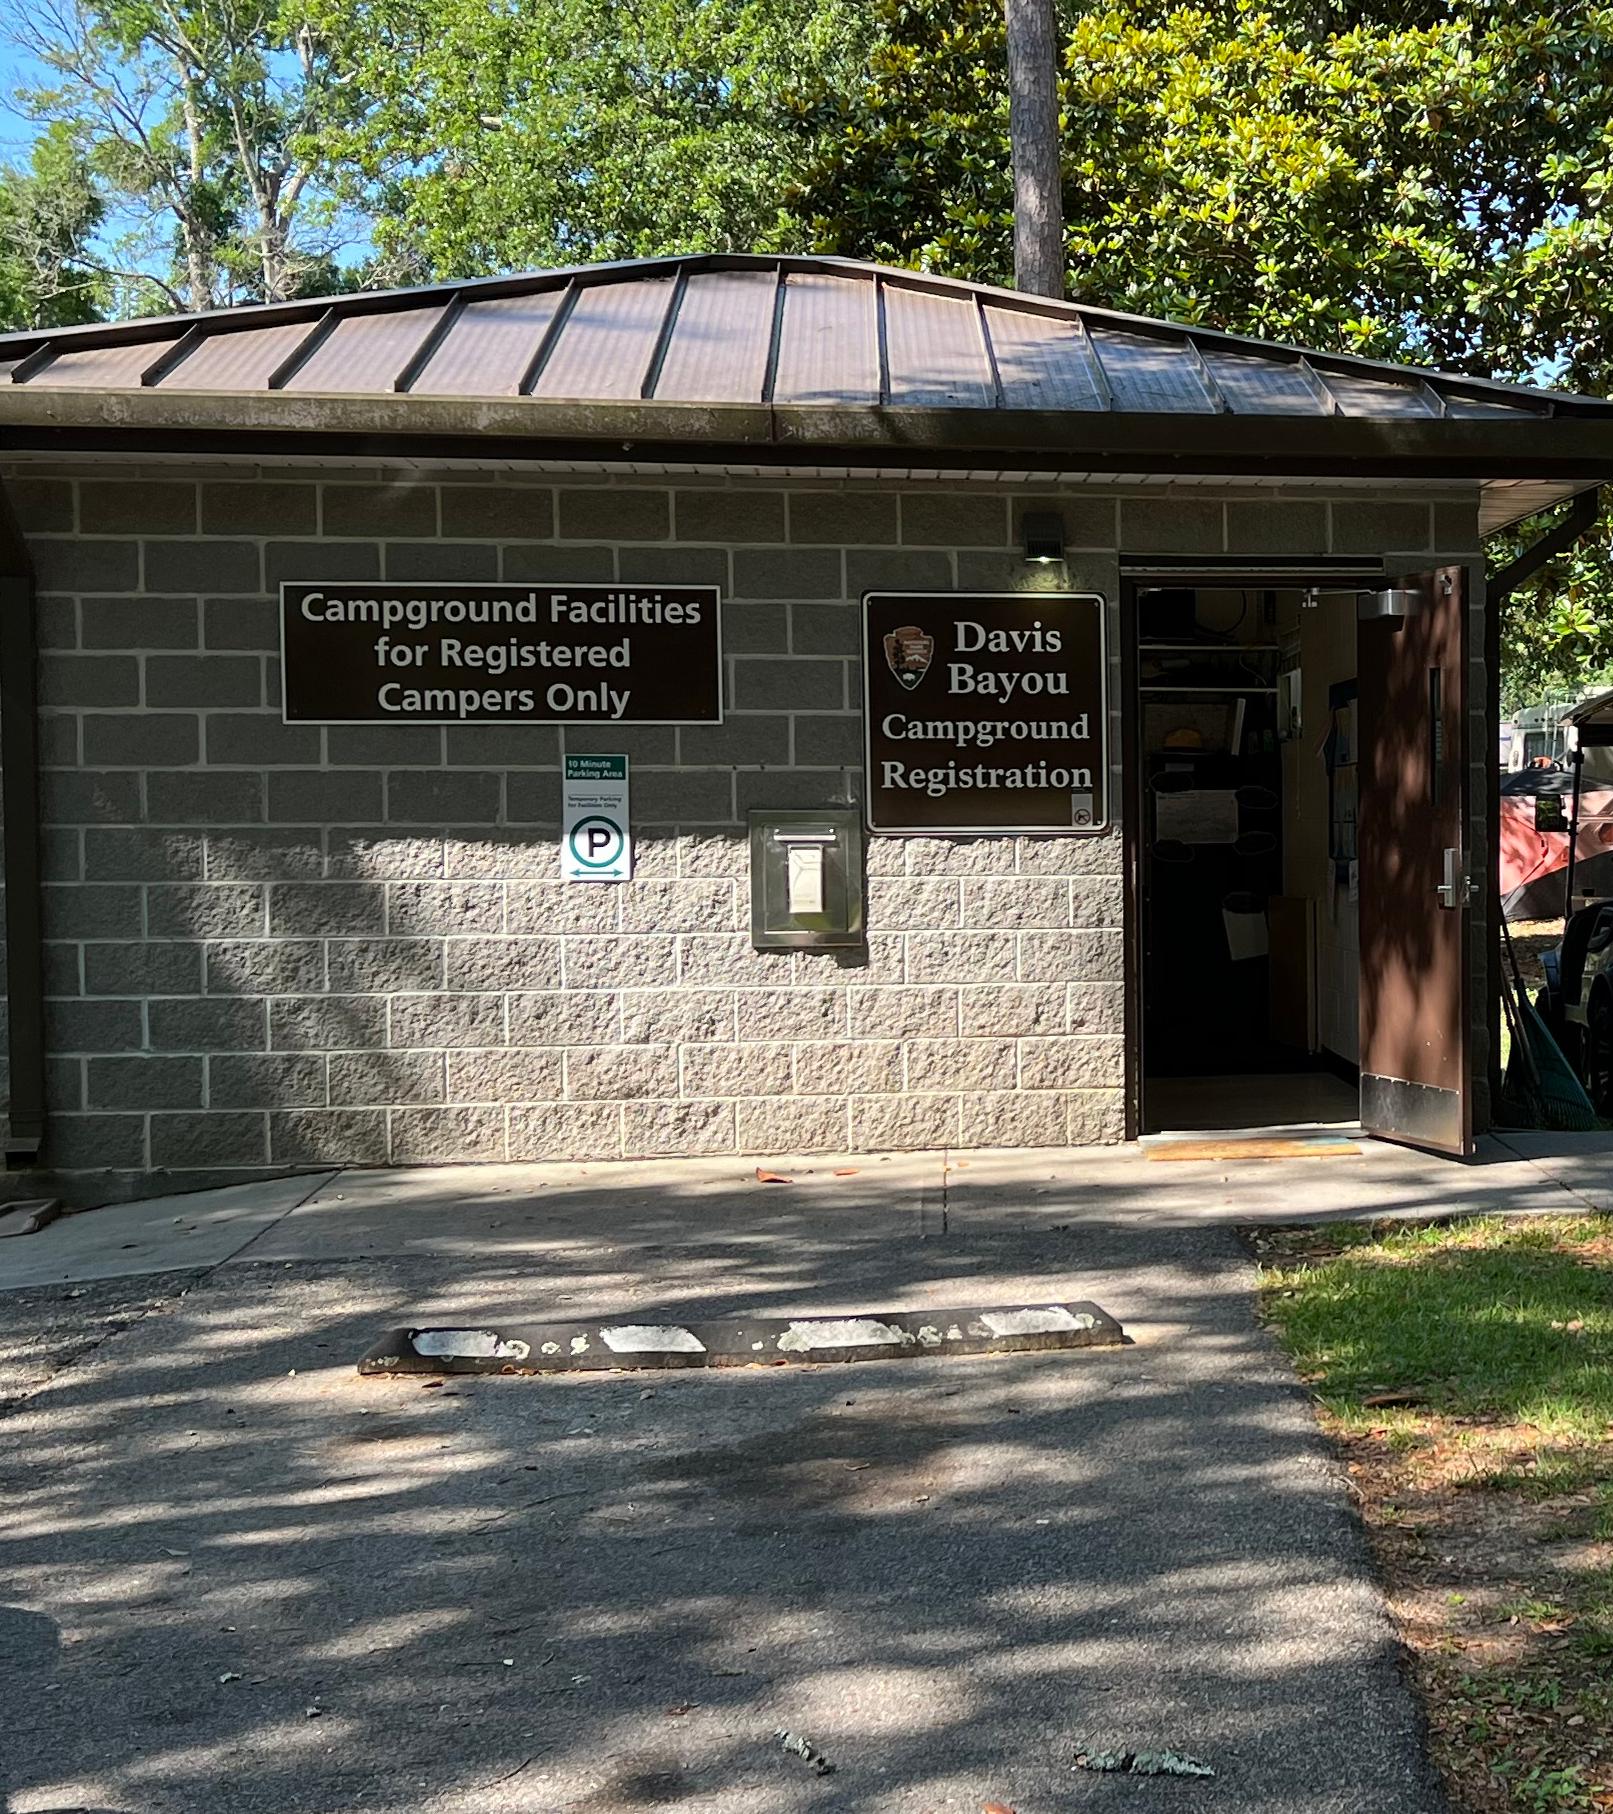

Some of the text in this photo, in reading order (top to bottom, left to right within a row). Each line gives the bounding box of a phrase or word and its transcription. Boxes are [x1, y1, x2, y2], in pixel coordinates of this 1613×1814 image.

[301, 593, 701, 629] Campground Facilities
[953, 621, 1062, 652] Davis
[374, 636, 631, 674] for Registered
[378, 683, 631, 718] Campers Only
[948, 663, 1069, 704] Bayou
[881, 713, 1090, 747] Campground
[567, 770, 622, 779] Parking Area
[568, 760, 611, 768] 10 Minute
[881, 761, 1093, 796] Registration
[588, 828, 611, 857] P
